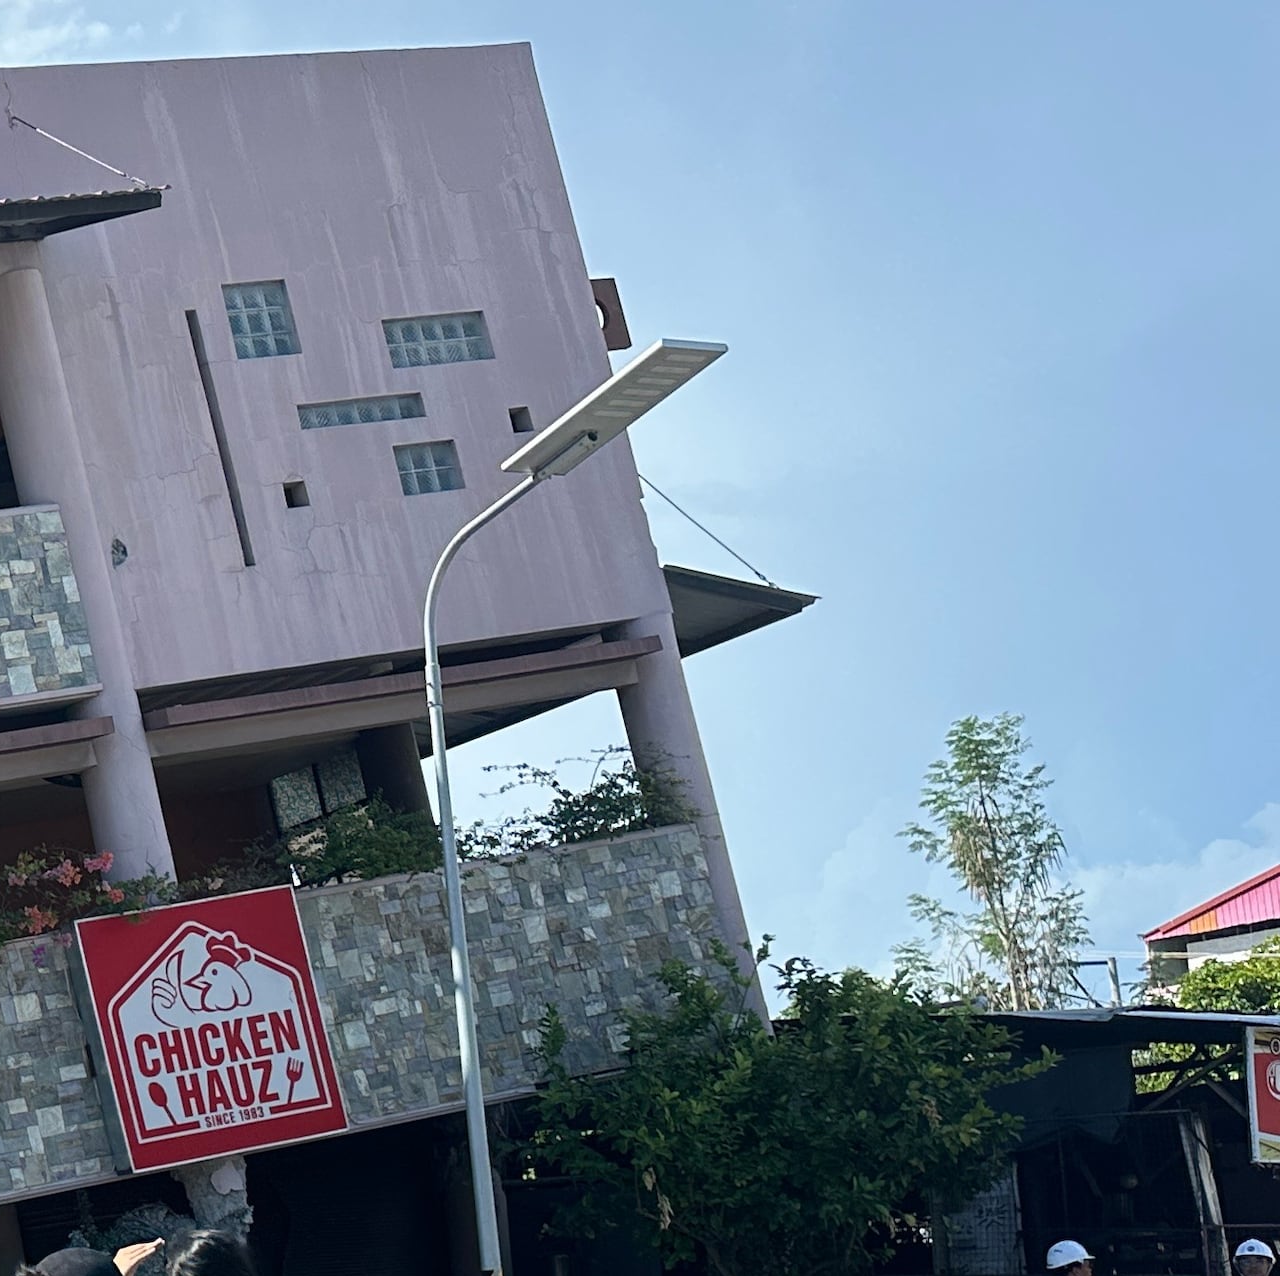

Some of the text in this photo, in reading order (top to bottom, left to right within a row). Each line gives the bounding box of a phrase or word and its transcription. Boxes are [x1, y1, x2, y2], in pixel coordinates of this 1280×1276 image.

[133, 1009, 301, 1078] CHICKEN
[176, 1059, 280, 1118] HAUZ
[204, 1106, 266, 1128] SINCE 1983
